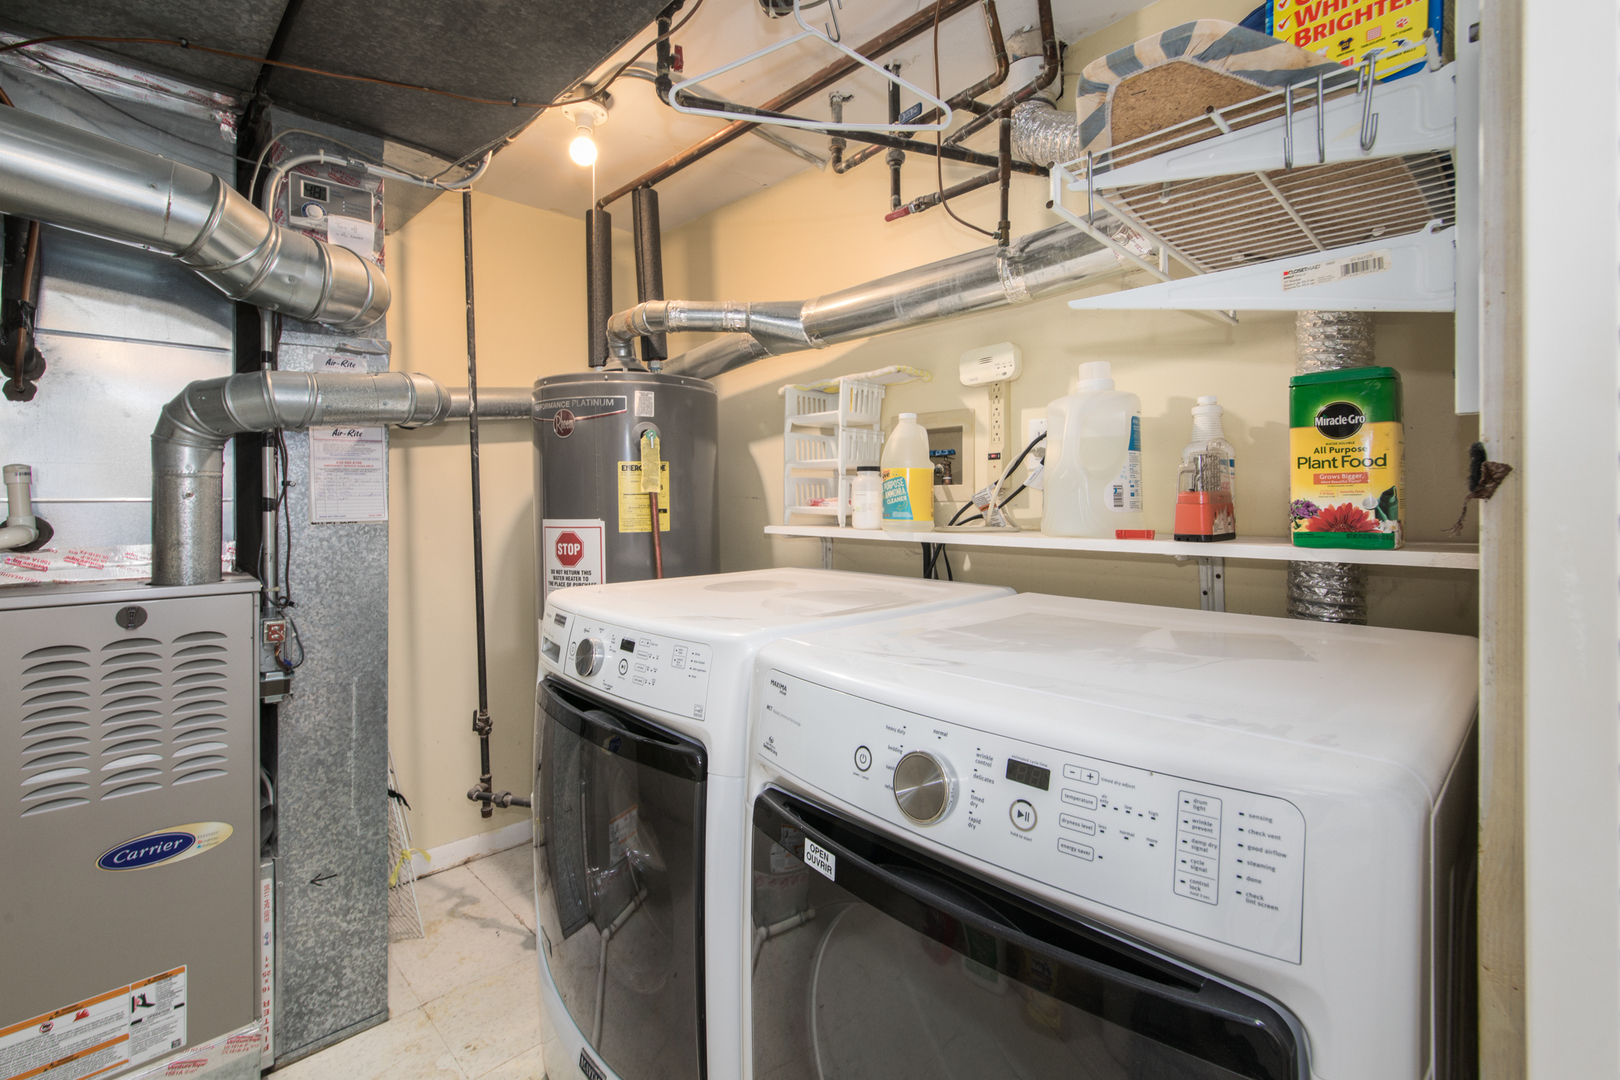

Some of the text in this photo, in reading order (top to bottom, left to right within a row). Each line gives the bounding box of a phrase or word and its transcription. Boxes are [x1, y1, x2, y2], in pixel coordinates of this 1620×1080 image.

[1294, 0, 1424, 48] BRIGHTE
[325, 357, 356, 368] Air-Rite
[572, 398, 615, 407] PLATINUM
[555, 408, 574, 433] Rheem
[332, 428, 363, 437] Air-Rite
[1329, 446, 1368, 455] Purpose
[1297, 453, 1387, 469] Plant Food
[557, 542, 581, 555] STOP
[886, 725, 896, 733] heavy
[933, 729, 948, 737] normal
[888, 745, 903, 755] bedding
[976, 753, 993, 761] wrinkle
[975, 759, 992, 768] control
[973, 773, 995, 785] delicates
[970, 794, 985, 803] timed
[1064, 793, 1093, 805] temperature
[1193, 798, 1208, 806] drum
[970, 801, 978, 809] dry
[1193, 804, 1206, 812] light
[968, 816, 981, 825] rapid
[1192, 818, 1213, 827] wrinkle
[1248, 813, 1273, 824] sensing
[968, 822, 976, 830] dry
[1061, 817, 1093, 831] dryness level
[1191, 824, 1213, 834] prevent
[1119, 830, 1135, 838] normal
[1248, 828, 1282, 841] check vent
[1191, 838, 1218, 850] damp dry
[1191, 844, 1208, 853] signal
[113, 838, 184, 864] Carrier
[810, 843, 829, 862] OPEN
[1060, 843, 1091, 856] energy saver
[1247, 844, 1287, 858] good airflow
[806, 851, 833, 875] OUVRIR
[1190, 858, 1205, 866] cycle
[1246, 860, 1276, 873] steaming
[1190, 864, 1208, 873] signal
[1189, 878, 1209, 888] control
[1246, 875, 1262, 884] done
[1189, 884, 1201, 892] lock
[1245, 891, 1264, 901] check
[1245, 898, 1279, 912] lint screen
[262, 1000, 271, 1051] FILTER
